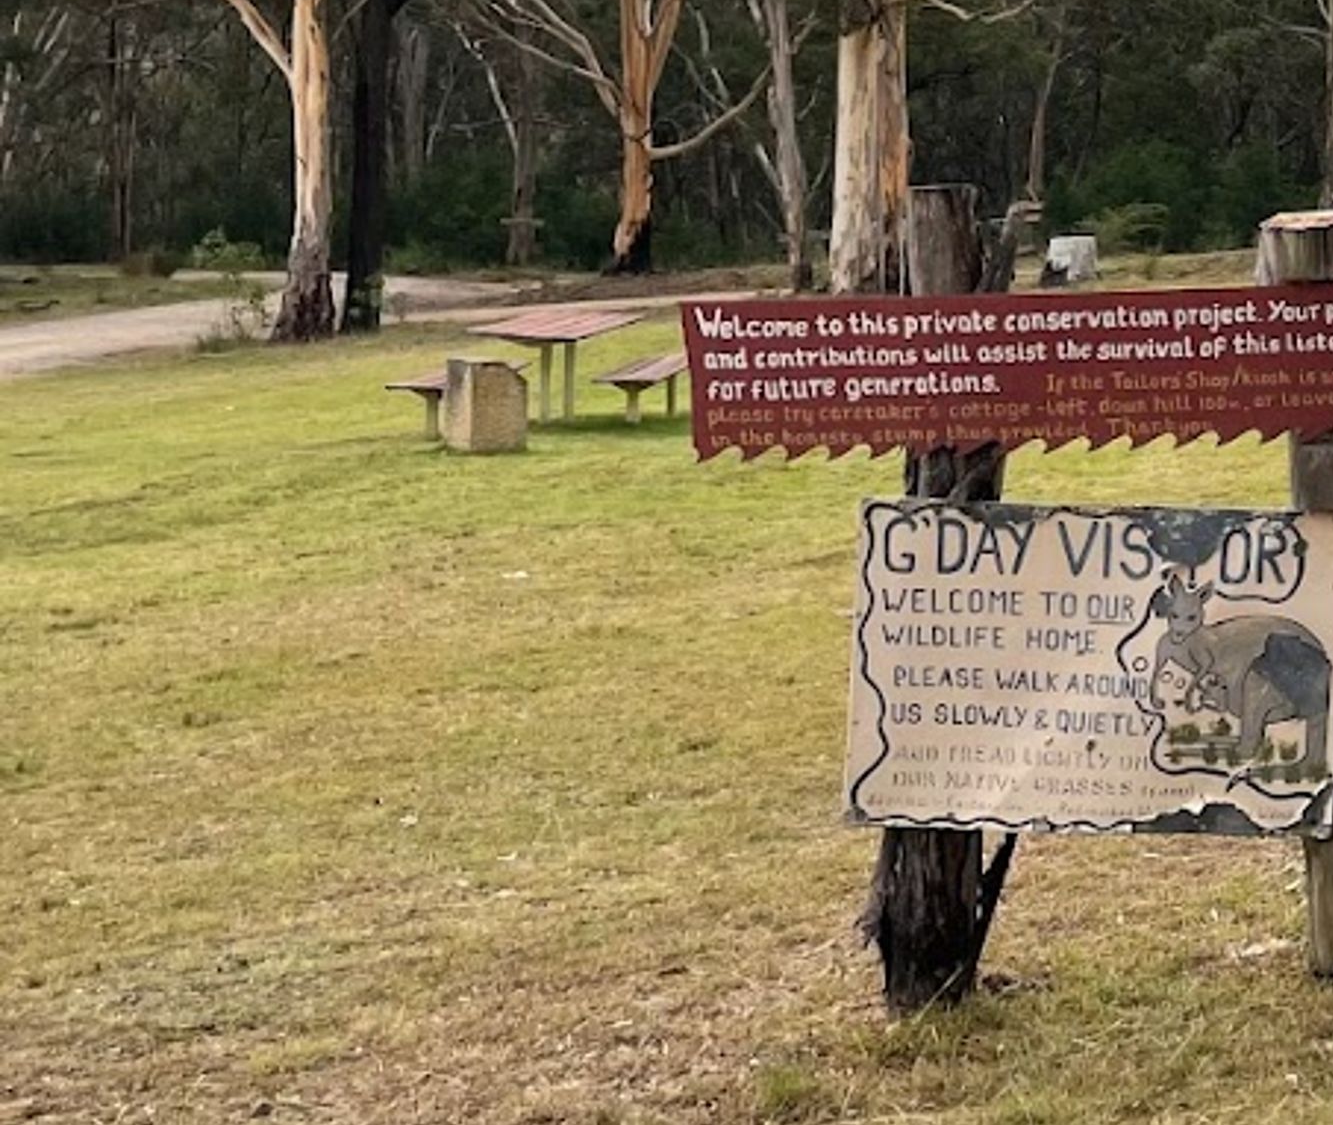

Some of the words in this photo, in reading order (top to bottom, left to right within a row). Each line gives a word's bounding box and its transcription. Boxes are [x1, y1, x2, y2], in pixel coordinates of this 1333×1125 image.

[694, 307, 809, 339] Welcome
[816, 313, 843, 336] to
[848, 311, 899, 335] this
[904, 309, 996, 339] private
[1003, 305, 1168, 333] conservation
[1174, 300, 1262, 332] project.
[1268, 299, 1319, 324] Your
[704, 347, 748, 370] and
[755, 342, 918, 369] contributions
[923, 341, 971, 365] will
[978, 340, 1047, 364] assist
[1056, 336, 1091, 361] the
[1096, 334, 1194, 361] survival
[1199, 335, 1228, 360] of
[1232, 332, 1281, 355] this
[707, 378, 746, 402] for
[750, 375, 837, 401] future
[843, 372, 1001, 403] generations.
[1069, 372, 1104, 391] the
[707, 406, 774, 428] please
[784, 405, 814, 427] try
[819, 399, 940, 423] caretaker's
[949, 398, 1031, 421] cottage
[1099, 394, 1148, 414] down
[1153, 394, 1193, 414] hill
[1254, 394, 1273, 409] or
[739, 429, 775, 446] the
[883, 516, 1037, 575] G'DAY
[1058, 520, 1287, 584] VISOR
[881, 588, 1024, 616] WELCOME
[1040, 591, 1078, 618] TO
[1087, 593, 1138, 622] OUR
[881, 624, 1006, 649] WILDLIFE
[893, 665, 984, 690] PLEASE
[996, 668, 1060, 693] WALK
[1064, 674, 1151, 700] AROUND
[890, 702, 922, 725] US
[934, 702, 1029, 728] SLOWLY
[1033, 708, 1050, 730] &
[1055, 708, 1157, 737] QUIETLY
